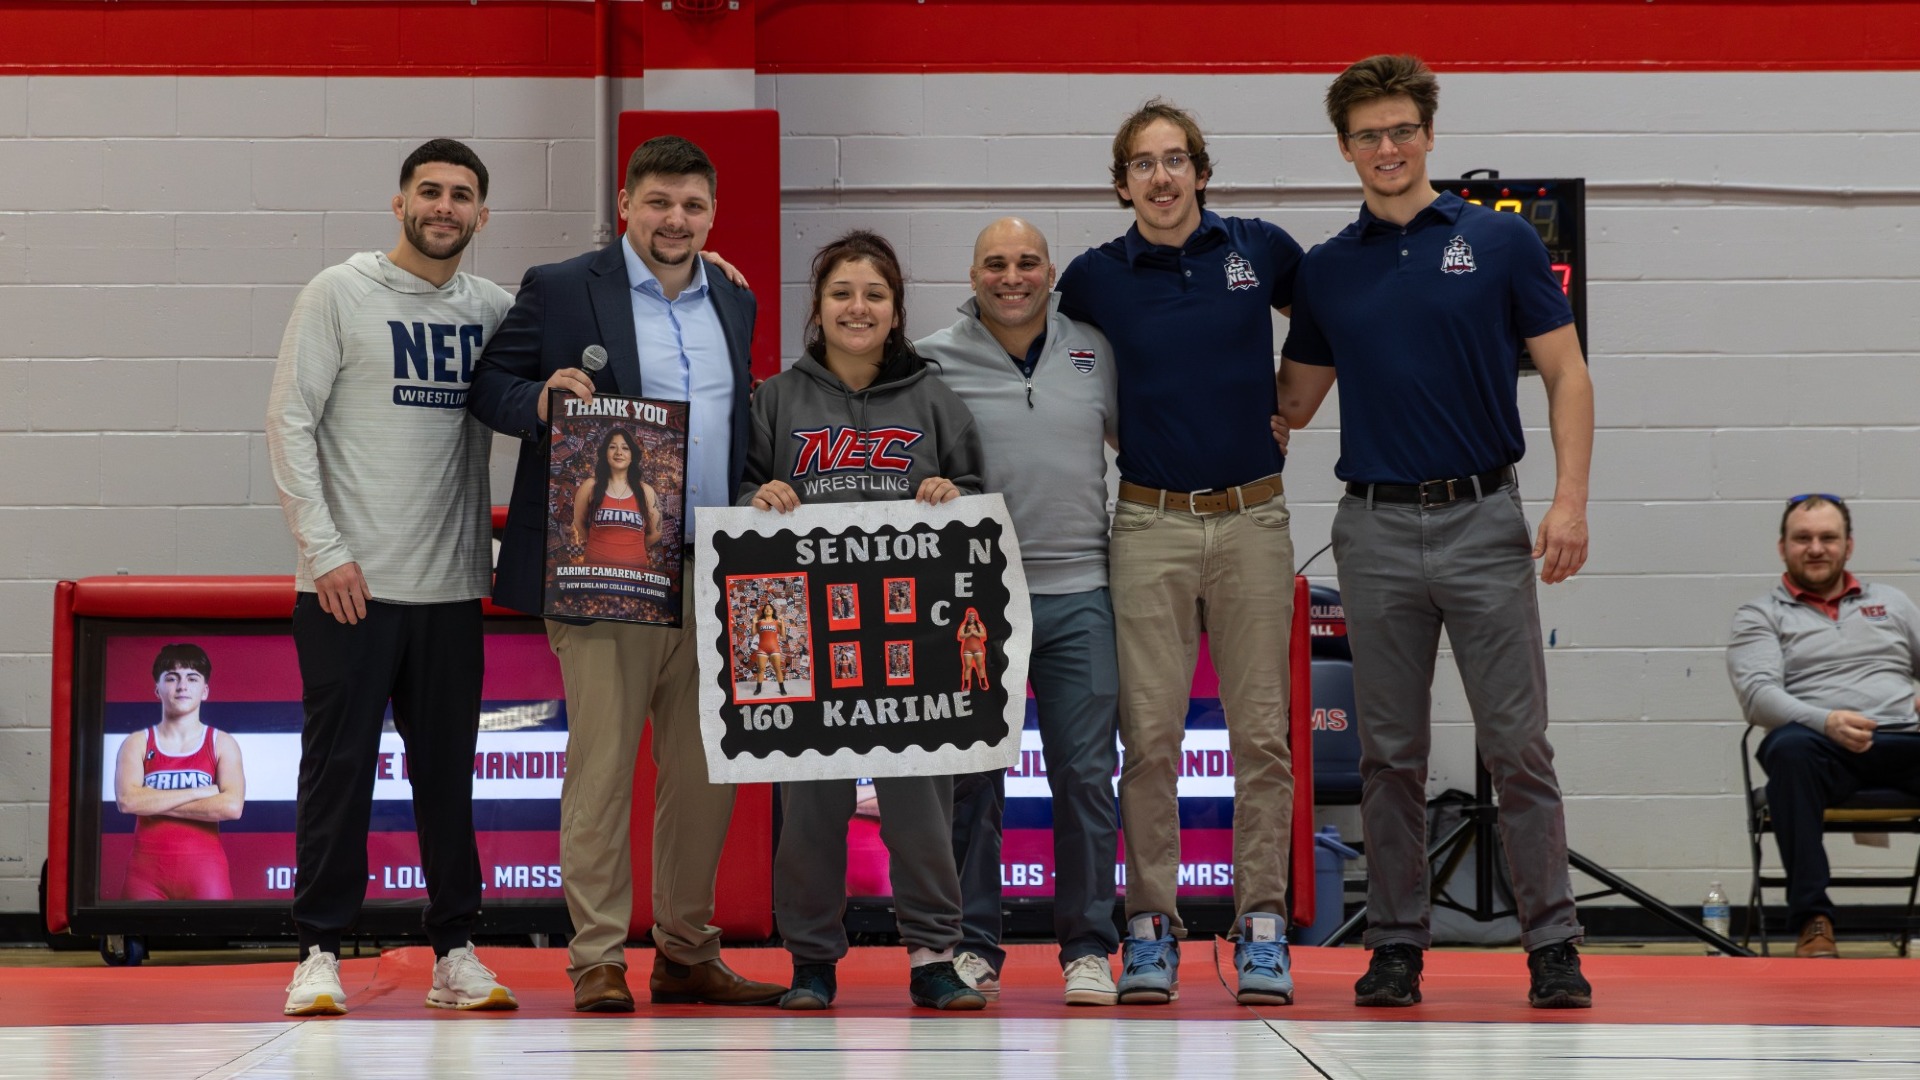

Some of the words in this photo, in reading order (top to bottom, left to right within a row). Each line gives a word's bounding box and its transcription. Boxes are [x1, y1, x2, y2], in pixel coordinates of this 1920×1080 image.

[1444, 255, 1474, 268] NEC
[1229, 271, 1256, 286] NEC
[387, 320, 484, 384] NEC
[398, 388, 469, 405] WRESTLIN
[564, 398, 630, 418] THANK
[632, 401, 668, 426] YOU
[792, 426, 924, 478] NEC
[803, 475, 910, 496] WRESTLING
[795, 532, 942, 565] SENIOR
[557, 567, 591, 576] KARIME
[591, 567, 671, 587] CAMARENA-TEJEDA
[580, 582, 609, 590] ENGLAND
[609, 584, 636, 592] COLLEGE
[739, 704, 794, 731] 160
[823, 690, 973, 727] KARIME
[494, 866, 563, 888] MASS
[1000, 864, 1044, 886] LBS
[1178, 864, 1234, 886] MAS
